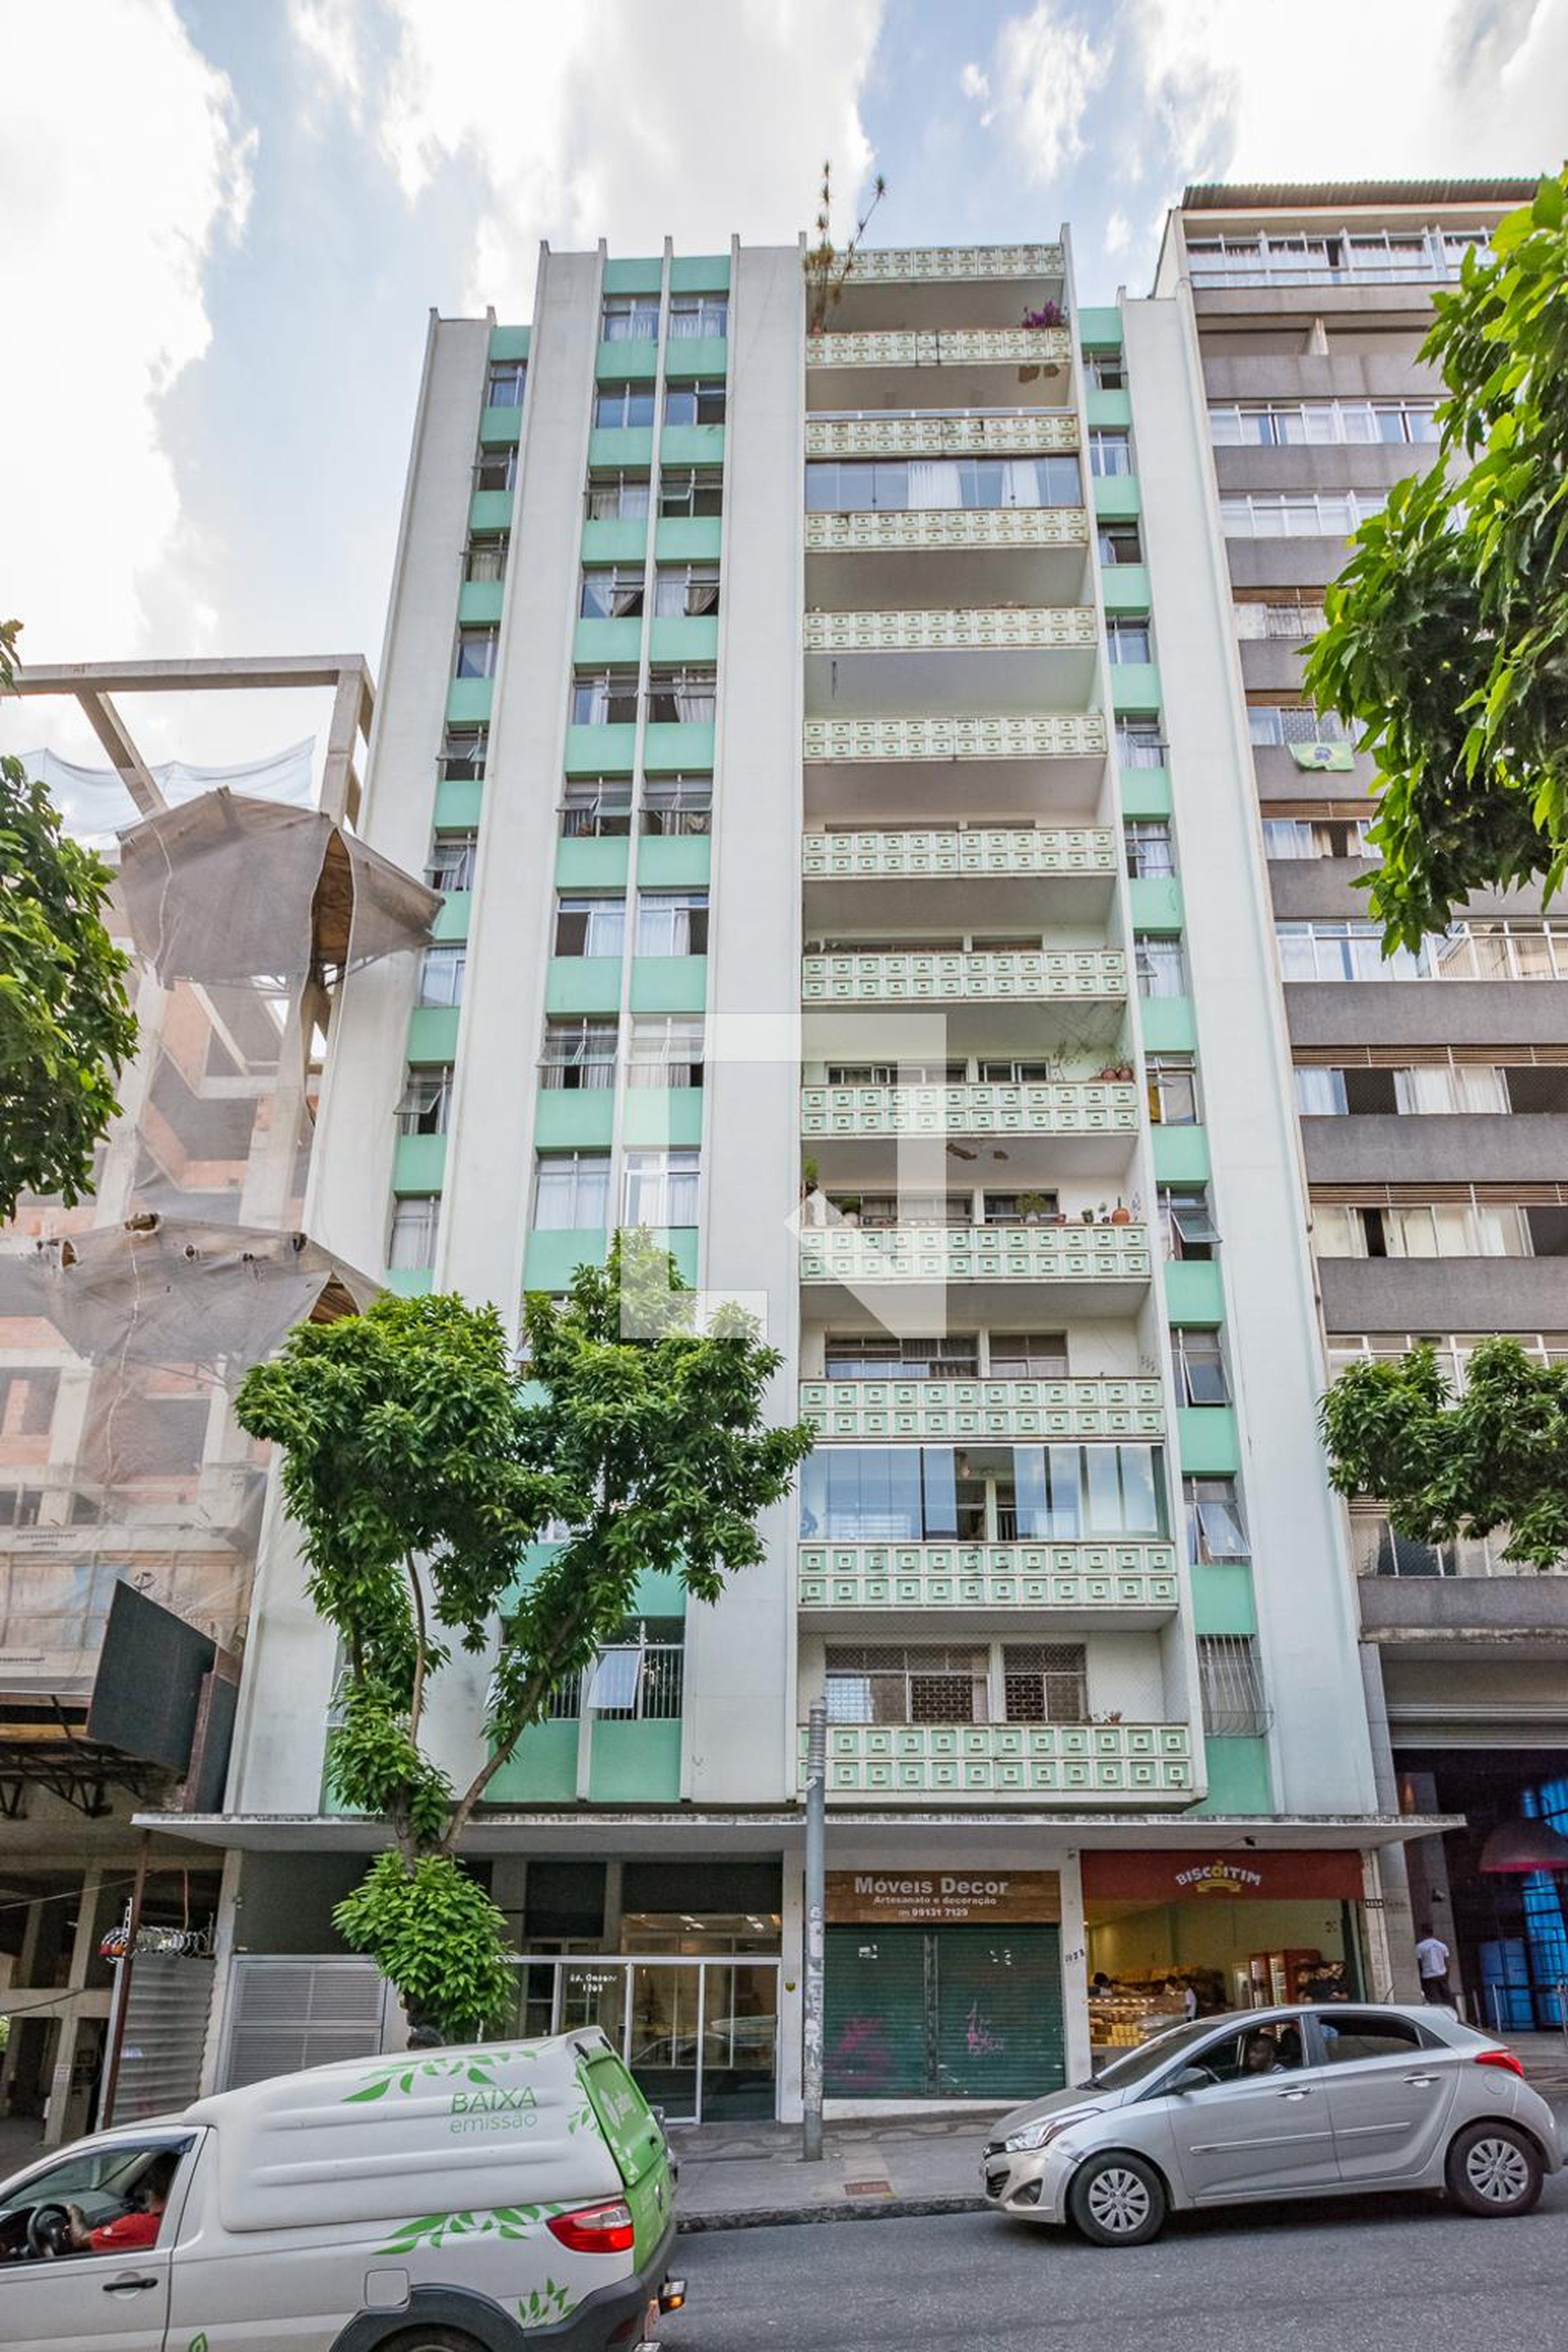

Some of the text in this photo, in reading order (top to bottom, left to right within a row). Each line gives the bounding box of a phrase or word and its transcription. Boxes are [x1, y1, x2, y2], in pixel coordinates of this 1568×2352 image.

[855, 1876, 1009, 1894] Móveis Decor
[1176, 1865, 1262, 1886] BISCOITIM
[873, 1896, 930, 1904] Artesanato
[942, 1896, 997, 1905] decoração
[451, 2087, 537, 2114] BAIXA
[450, 2110, 538, 2134] emissão
